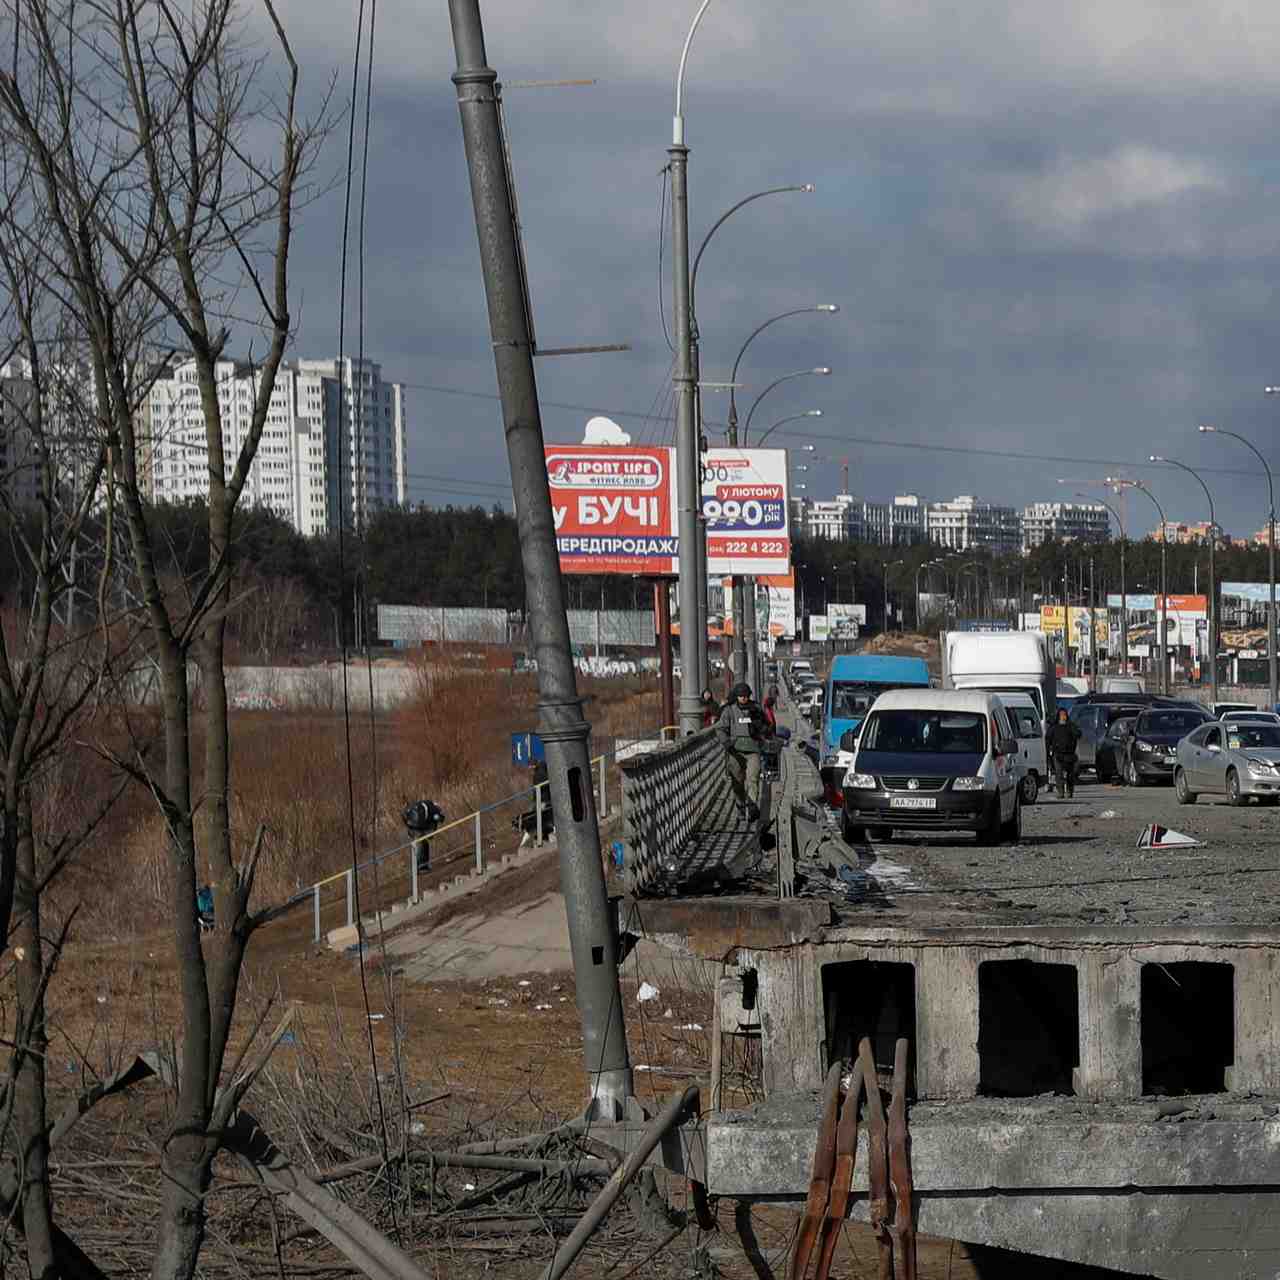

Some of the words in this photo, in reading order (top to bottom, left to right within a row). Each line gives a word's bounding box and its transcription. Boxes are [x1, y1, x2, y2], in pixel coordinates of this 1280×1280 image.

[577, 463, 621, 474] SPORT
[624, 463, 652, 474] LIFE
[732, 488, 780, 499] лютому
[578, 496, 659, 526] БУЧІ
[703, 500, 763, 526] 990
[763, 503, 781, 513] грн
[764, 512, 781, 523] рік
[726, 542, 748, 553] 222
[750, 542, 758, 553] 4
[761, 542, 783, 553] 222
